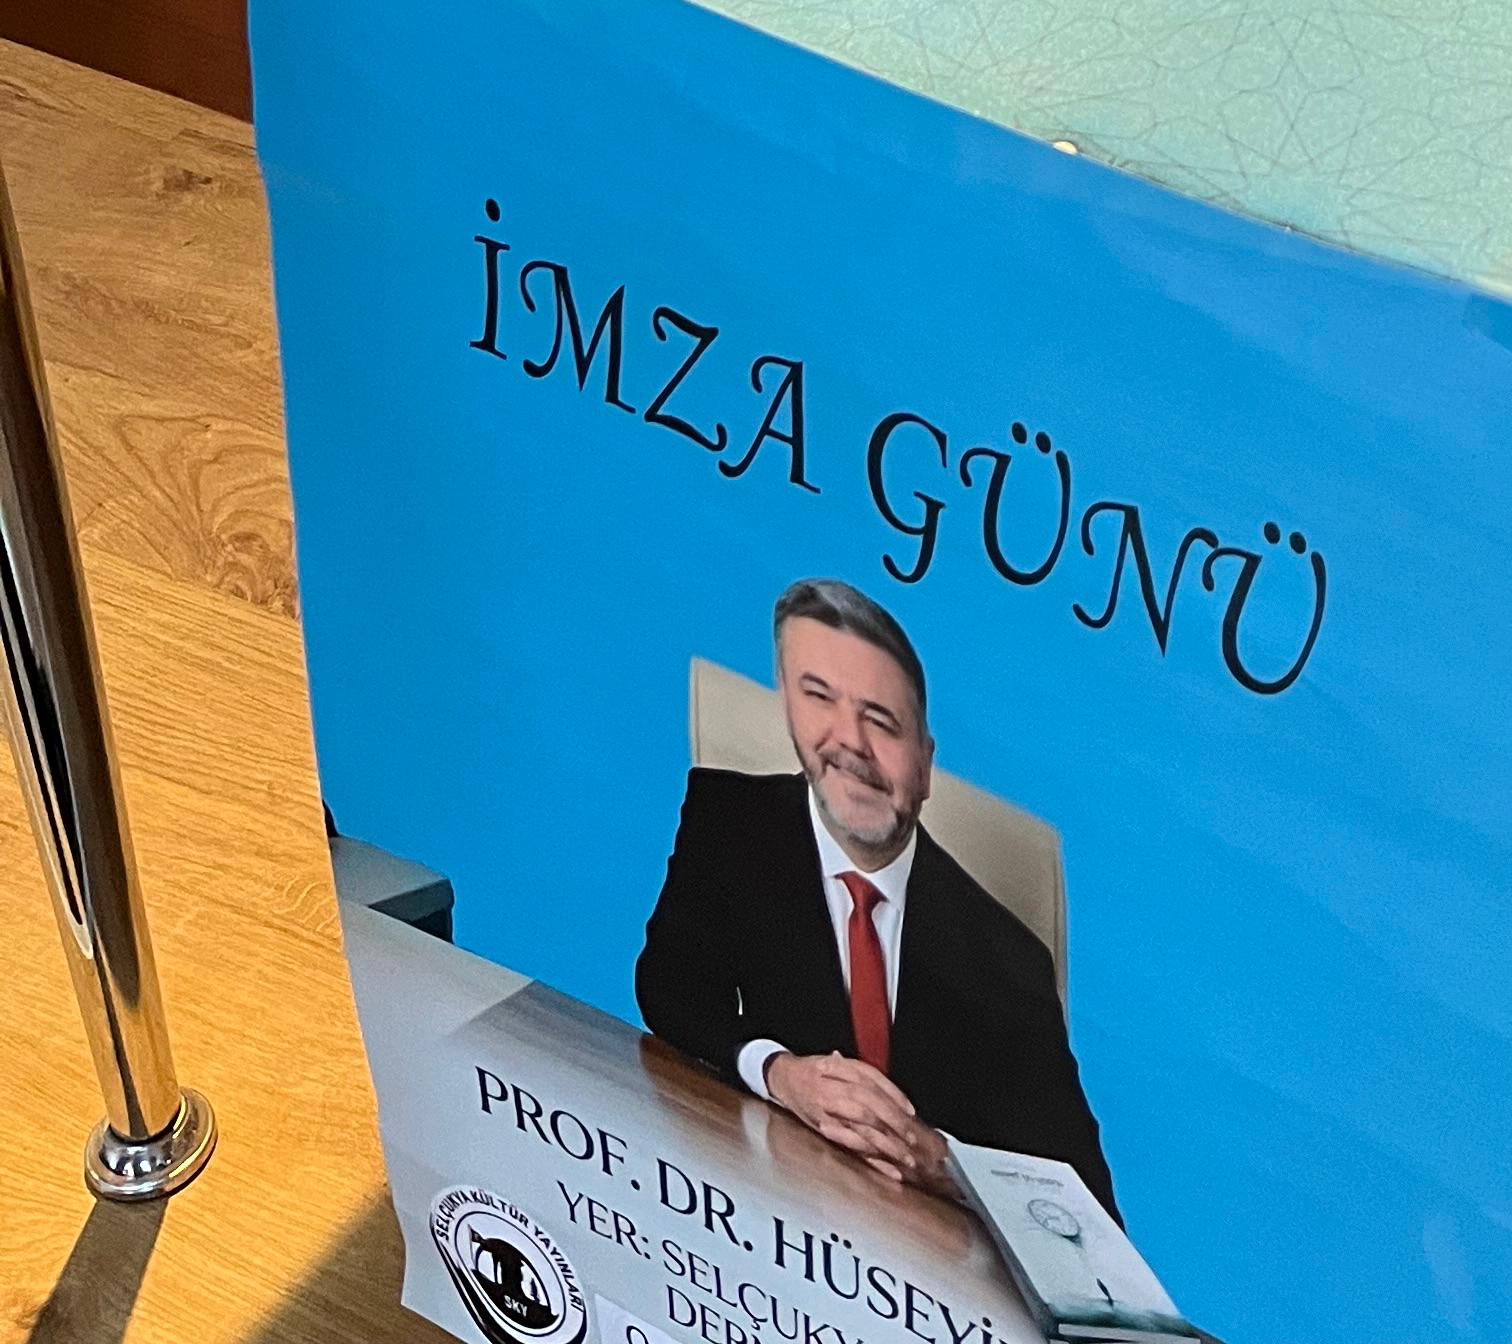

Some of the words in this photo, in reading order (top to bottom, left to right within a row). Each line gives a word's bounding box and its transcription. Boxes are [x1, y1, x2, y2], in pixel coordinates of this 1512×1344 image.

[468, 197, 822, 494] İMZA
[867, 411, 1328, 696] GÜNÜ
[469, 1188, 529, 1228] KÜLTÜR
[534, 1225, 584, 1313] YAYINLARI
[473, 1064, 641, 1192] PROF.
[658, 1157, 755, 1253] DR.
[773, 1216, 1010, 1344] HÜSEYİ
[556, 1179, 652, 1261] YER:
[504, 1294, 528, 1317] SKY
